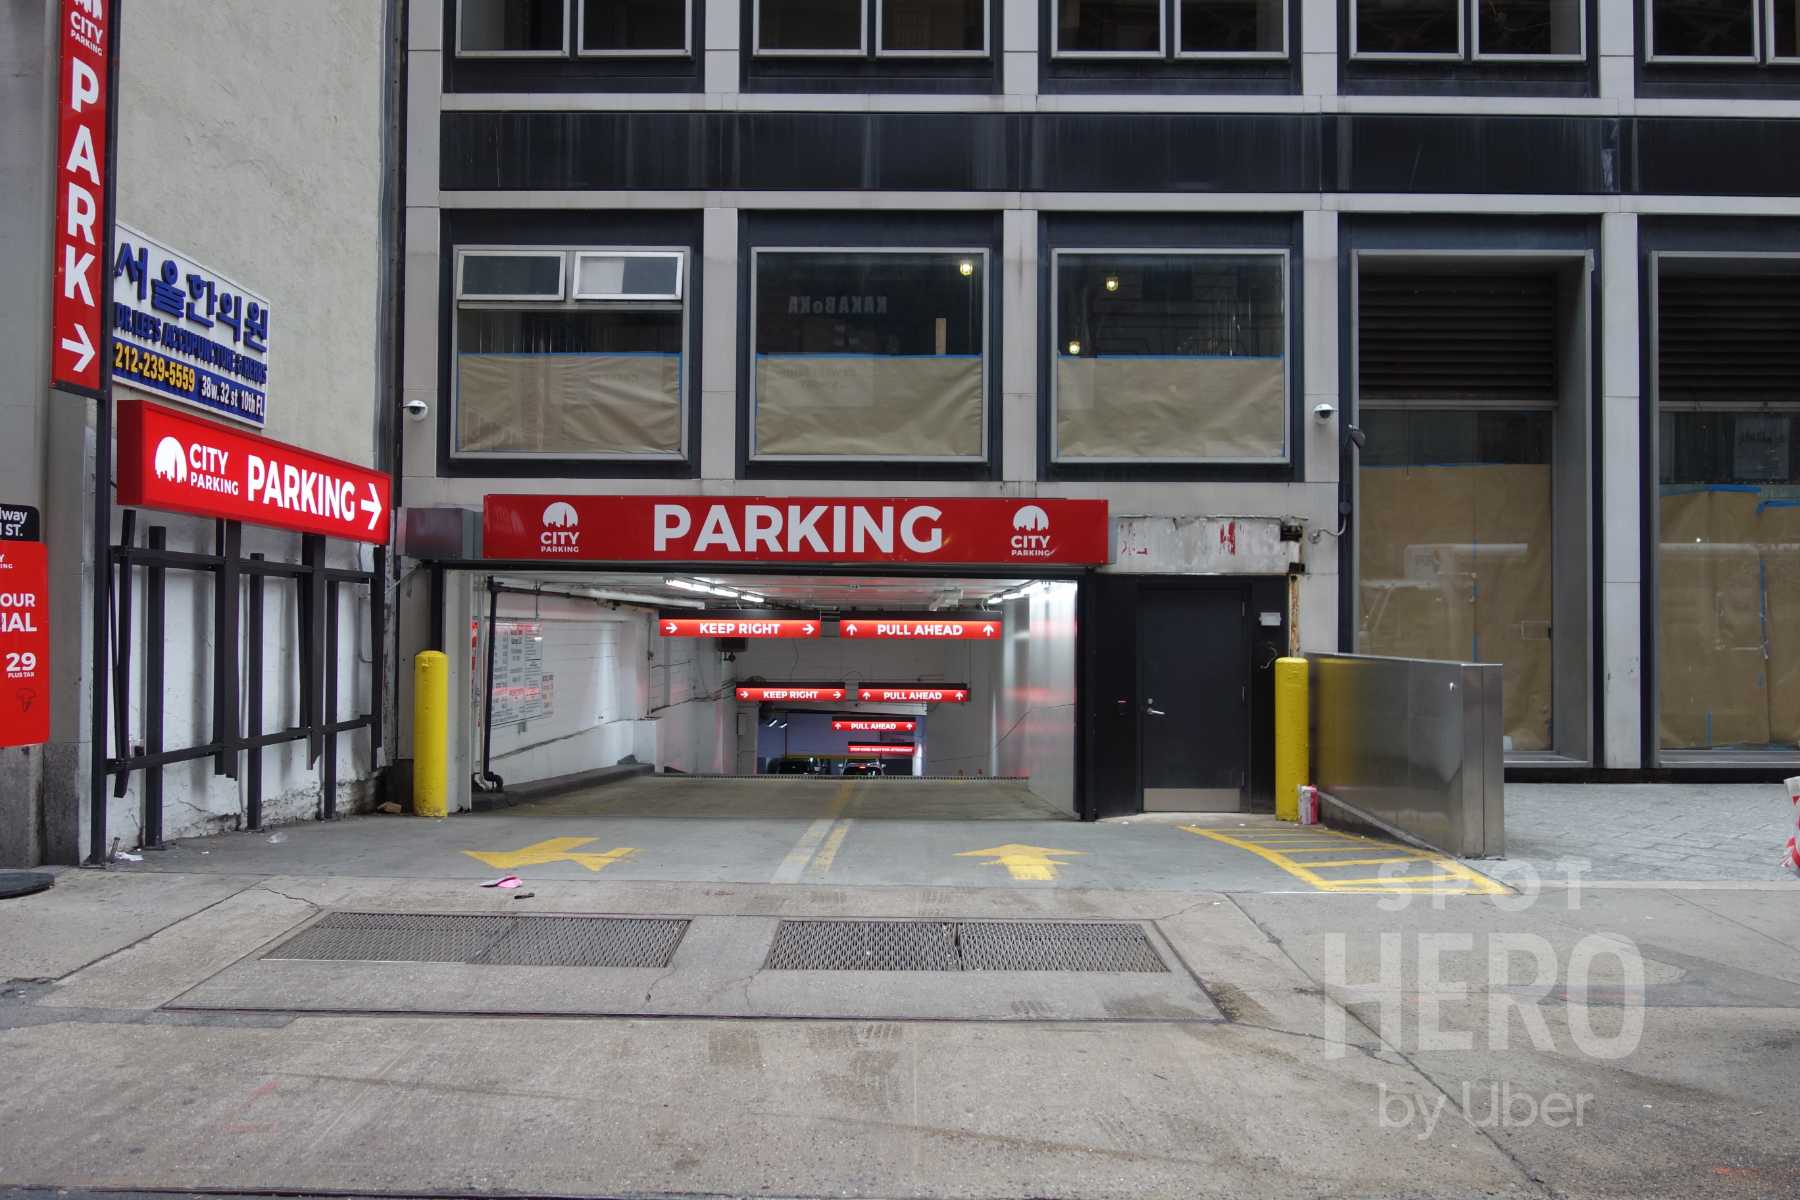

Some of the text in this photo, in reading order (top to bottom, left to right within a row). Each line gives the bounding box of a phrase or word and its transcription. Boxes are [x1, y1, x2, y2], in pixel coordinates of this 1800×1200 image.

[70, 11, 103, 44] CITY
[71, 29, 103, 57] PARKING
[66, 56, 101, 308] PARK
[113, 243, 268, 353] 서울한의원
[115, 343, 196, 392] 212-239-5559
[242, 390, 256, 413] 10th
[256, 395, 264, 417] FL
[190, 443, 228, 475] CITY
[190, 473, 239, 496] PARKING
[248, 454, 356, 521] PARKING
[5, 524, 23, 536] ST.
[540, 531, 580, 545] CITY
[653, 505, 944, 553] PARKING
[1010, 535, 1051, 548] CITY
[1011, 549, 1051, 557] PARKING
[699, 623, 780, 635] KEEP RIGHT
[877, 624, 963, 636] PULL AHEAD
[6, 652, 37, 672] 29
[763, 691, 818, 700] KEEP RIGHT
[884, 692, 942, 701] PULL AHEAD
